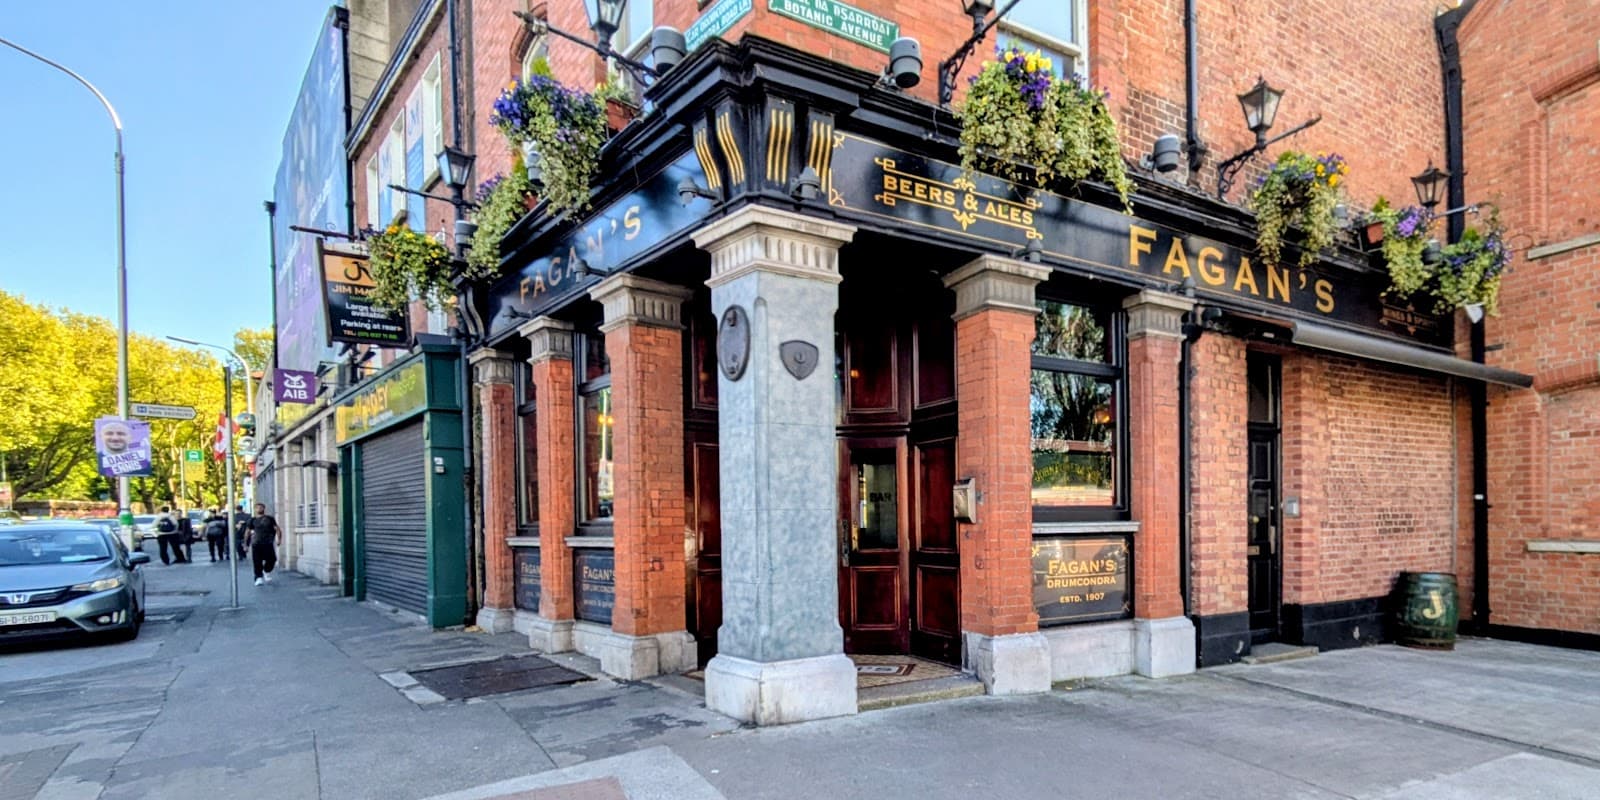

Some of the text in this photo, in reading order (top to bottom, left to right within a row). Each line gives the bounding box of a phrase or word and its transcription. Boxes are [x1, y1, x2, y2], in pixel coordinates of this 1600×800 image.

[784, 1, 884, 46] BOTANIC AVENUE
[883, 174, 1033, 226] BEERS & ALES
[519, 205, 642, 305] FAGAN'S
[1129, 224, 1335, 314] FAGAN'S
[331, 285, 352, 294] JIM
[345, 302, 369, 312] Large
[341, 319, 371, 330] Parking
[283, 389, 308, 400] AIB
[107, 451, 144, 465] DANIEL
[521, 562, 541, 575] FAGAN
[1048, 559, 1115, 575] FAGAN'S
[1046, 576, 1116, 589] DRUMCONDRA
[1060, 592, 1105, 604] ESTD. 1907
[1422, 590, 1443, 619] J
